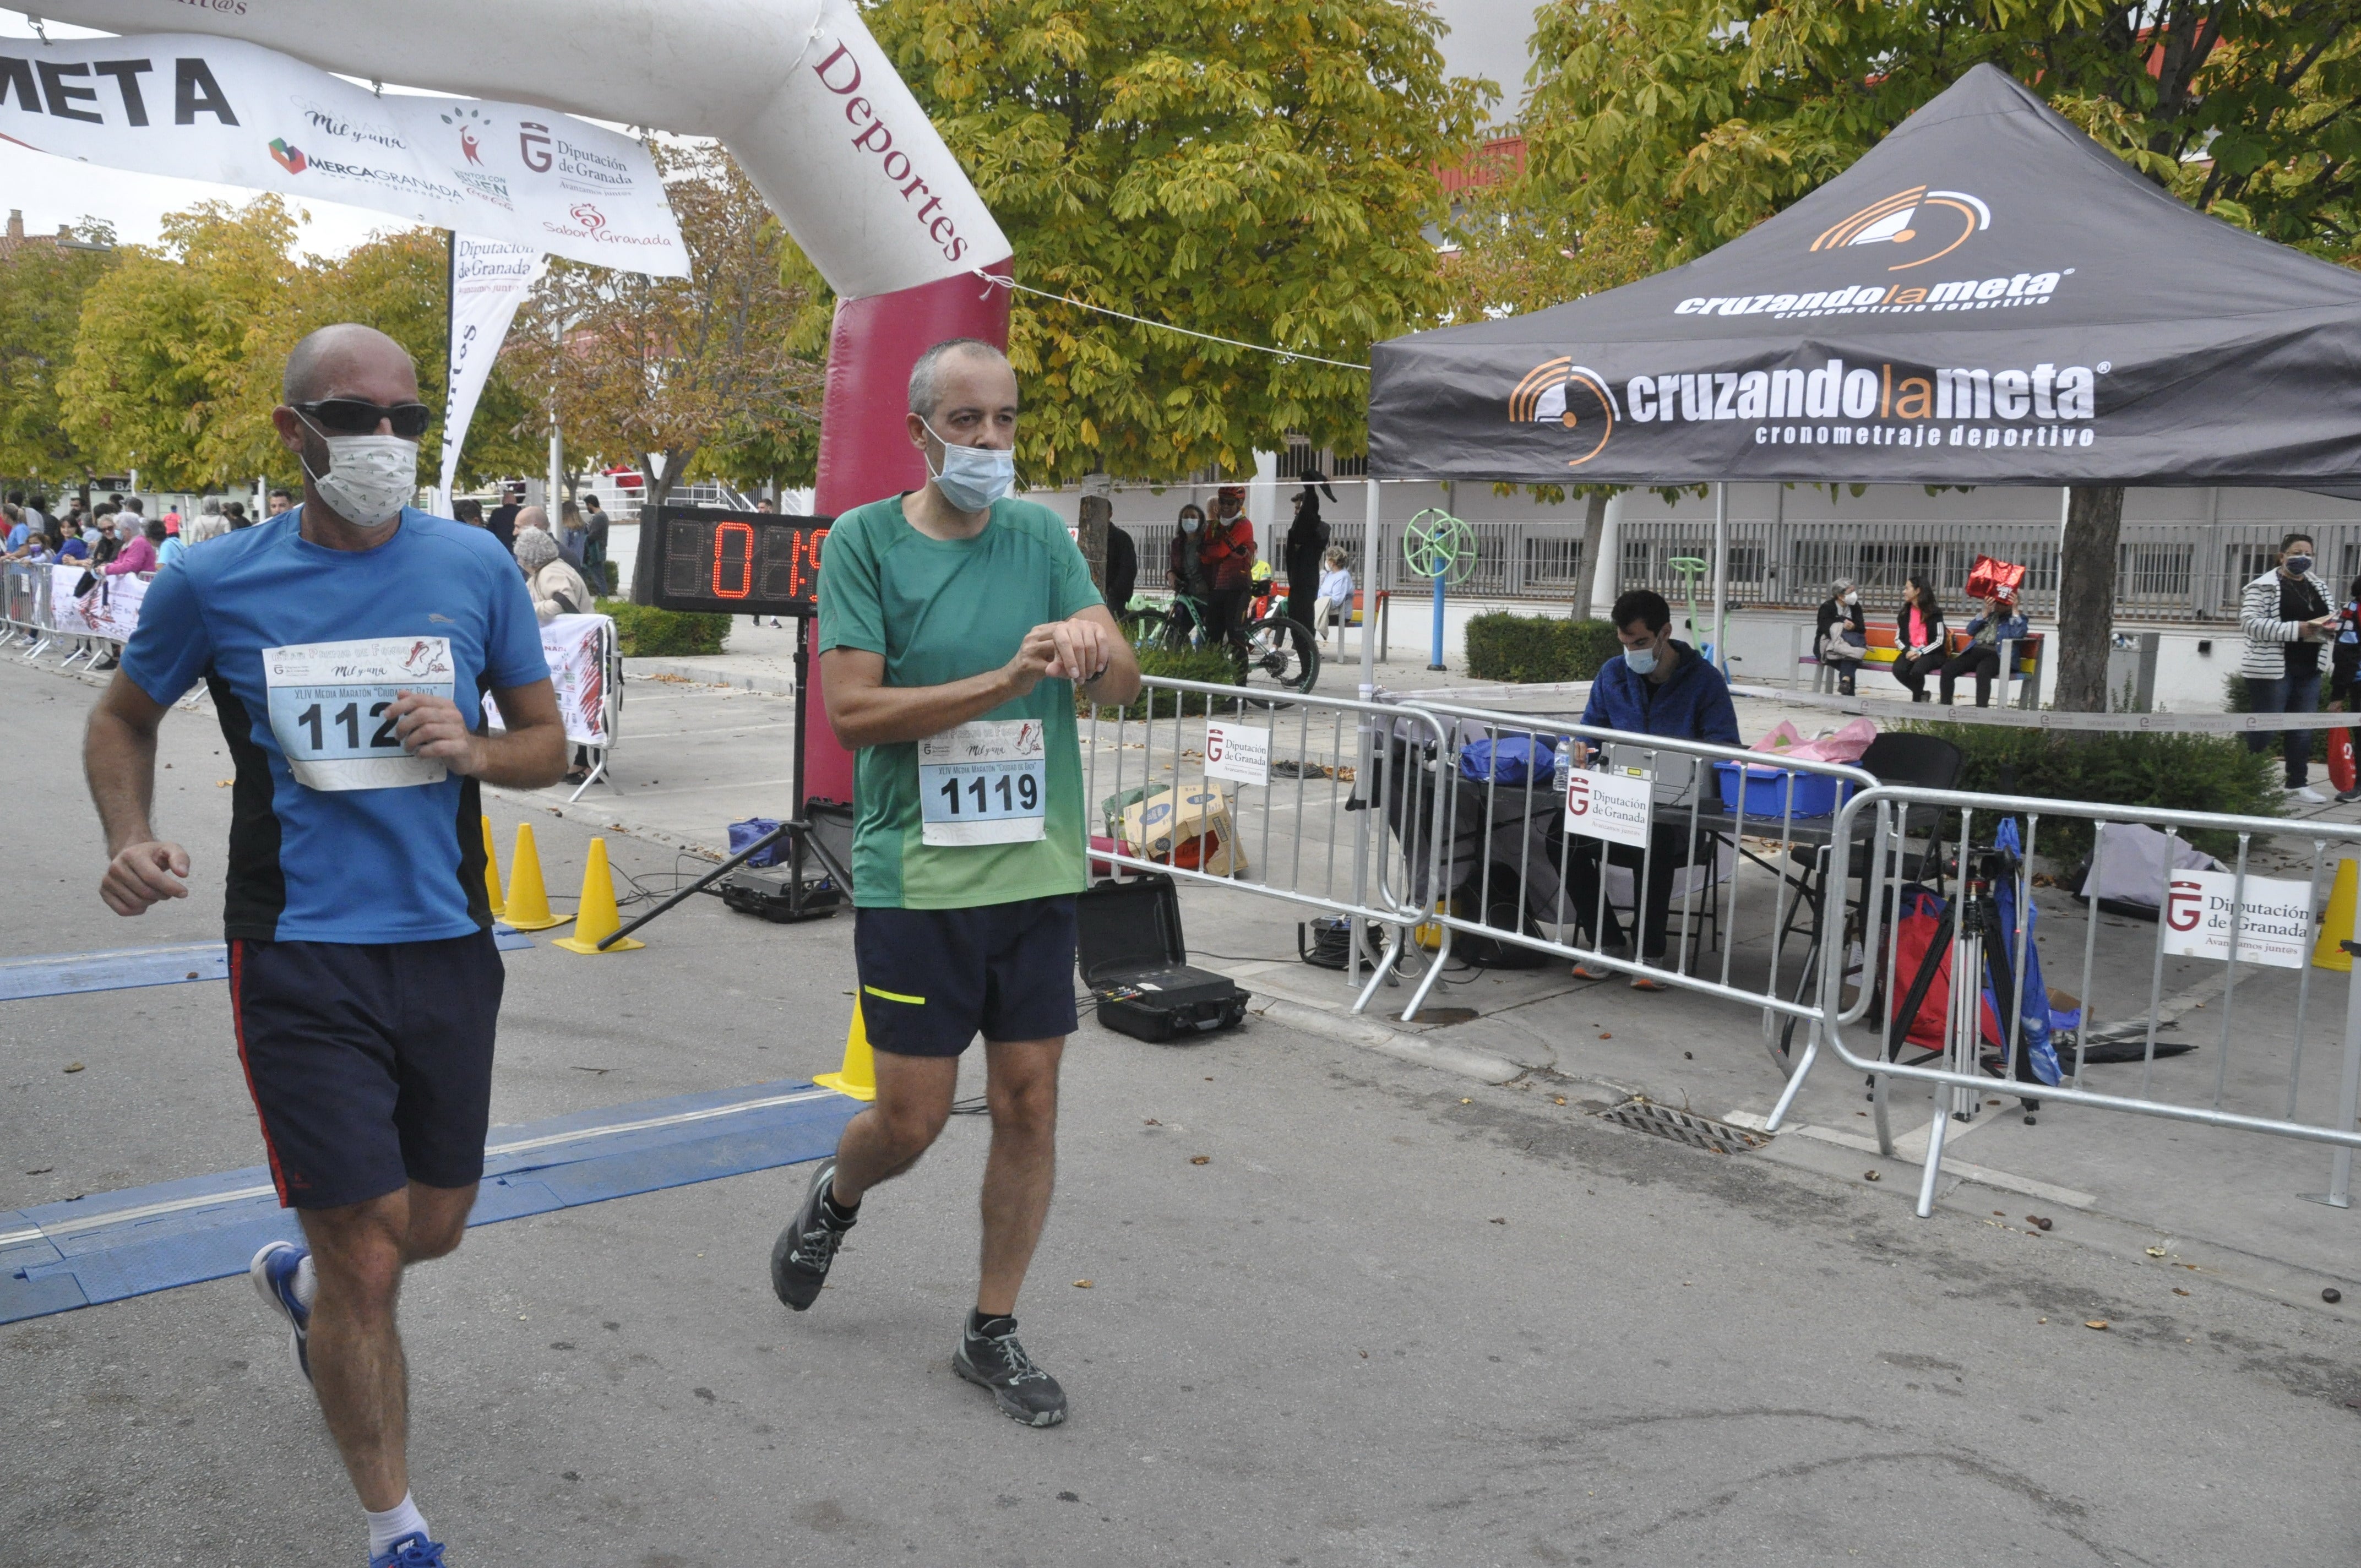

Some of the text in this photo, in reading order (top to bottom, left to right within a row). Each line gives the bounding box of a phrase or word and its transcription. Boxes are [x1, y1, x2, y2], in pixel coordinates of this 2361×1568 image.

[304, 111, 349, 135] Mil
[368, 134, 406, 149] una
[557, 140, 628, 172] Diputación
[812, 38, 967, 262] Deportes
[308, 154, 465, 200] MERCAGRANADA
[488, 176, 506, 184] CON
[559, 159, 633, 184] de Granada
[543, 222, 672, 246] Sabor Granada
[459, 259, 530, 279] de Granada
[1774, 296, 2050, 319] cronometraje deportivo
[1755, 425, 2094, 449] cronometraje deportivo
[331, 666, 357, 677] Mil
[366, 667, 388, 677] una
[295, 689, 312, 699] XLIV
[965, 745, 983, 756] Mil
[1226, 739, 1266, 754] Diputación
[1225, 752, 1265, 766] de Granada
[938, 766, 951, 775] XLIV
[941, 774, 1037, 814] 1119
[1593, 790, 1646, 809] Diputación
[1593, 804, 1645, 824] de Granada
[2208, 915, 2306, 937] de Granada
[2205, 937, 2298, 955] Avanamos junt@s
